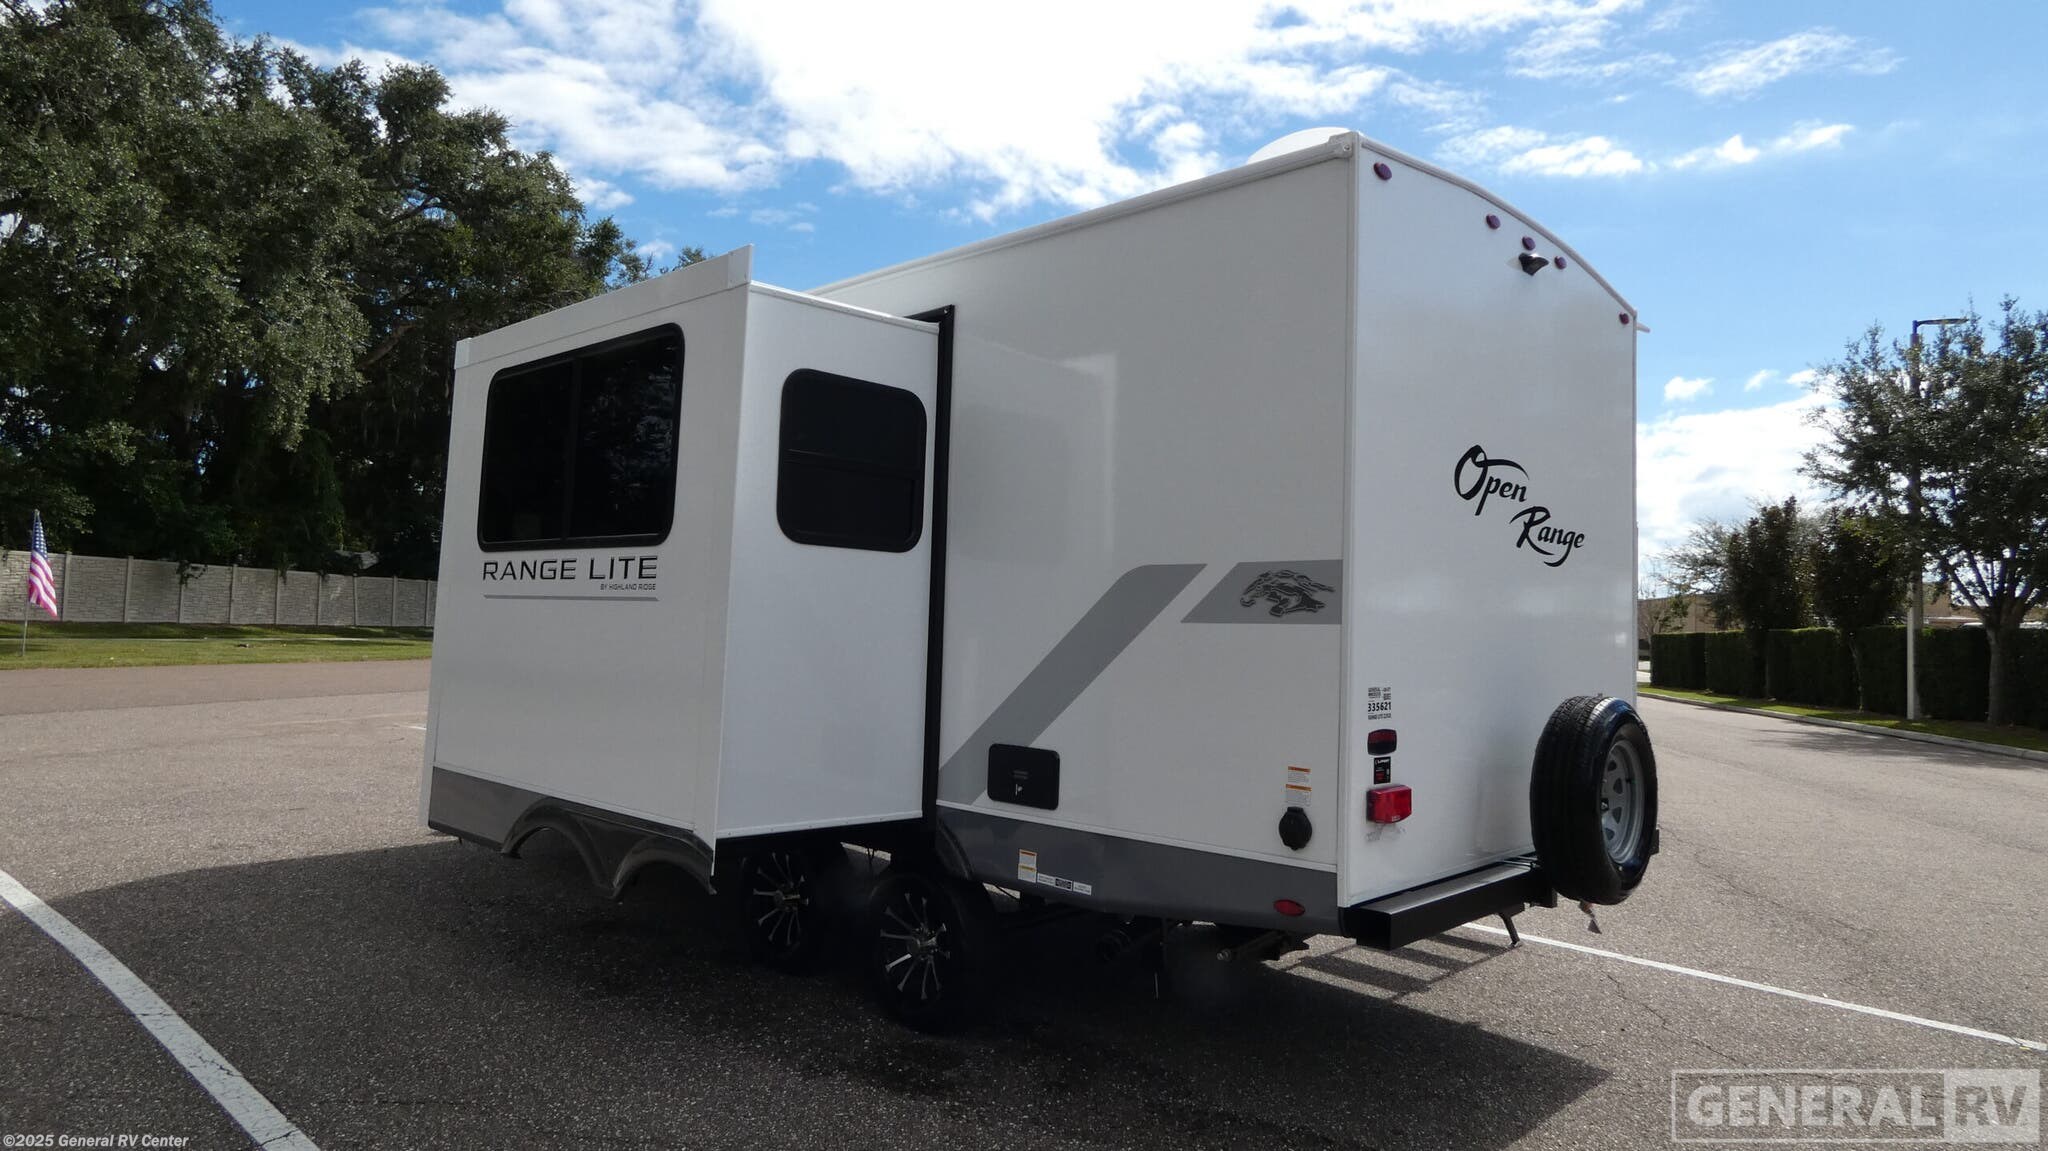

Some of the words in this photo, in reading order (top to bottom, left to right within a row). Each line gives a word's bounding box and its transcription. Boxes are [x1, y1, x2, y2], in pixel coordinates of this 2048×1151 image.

[1454, 444, 1530, 516] Open
[1509, 506, 1585, 567] Range
[482, 558, 577, 581] RANGE
[588, 555, 658, 580] LITE
[600, 583, 608, 591] BY
[608, 583, 637, 591] HIGHLAND
[1368, 702, 1391, 712] 335621
